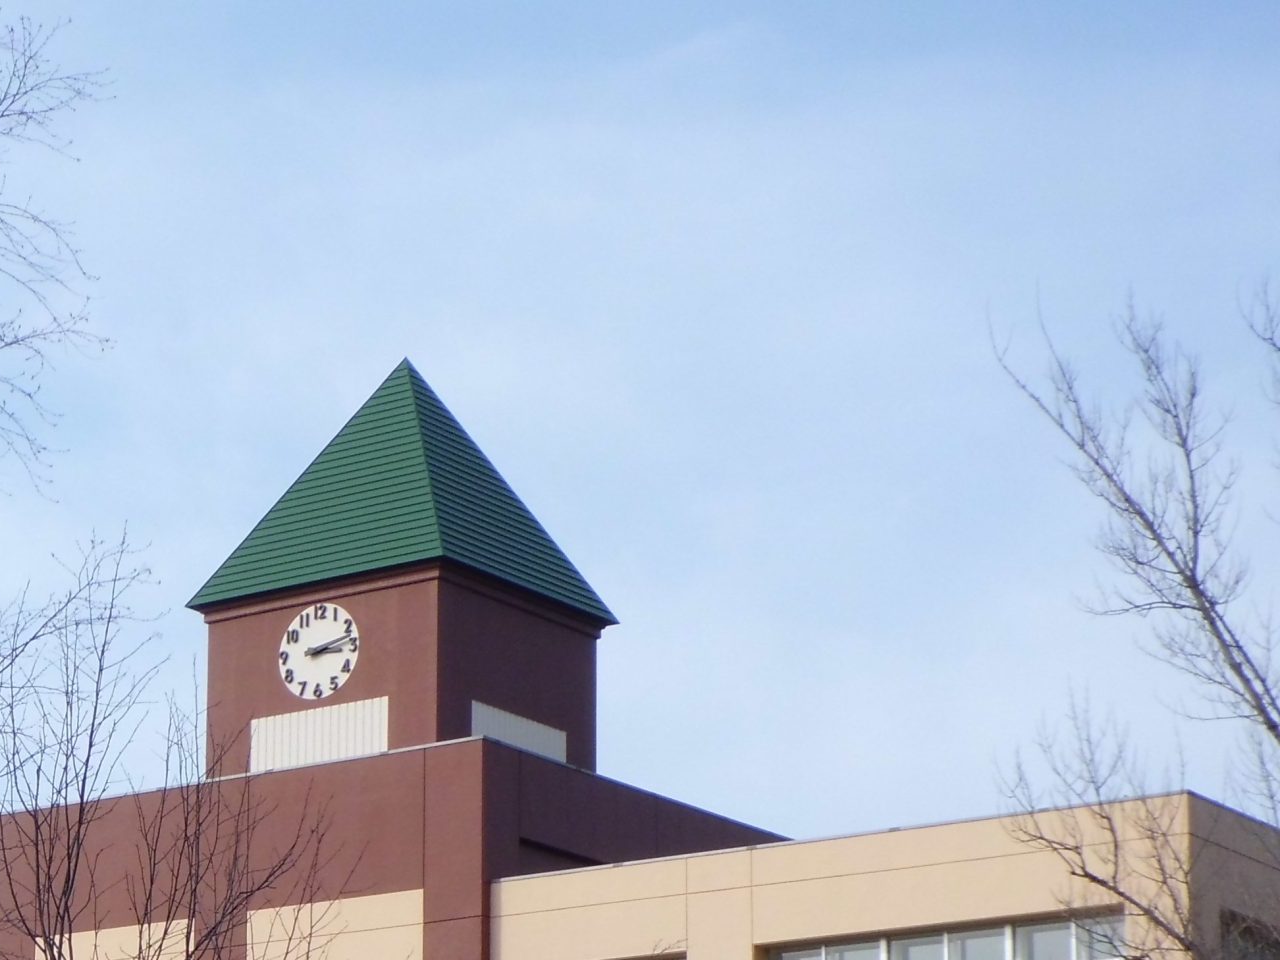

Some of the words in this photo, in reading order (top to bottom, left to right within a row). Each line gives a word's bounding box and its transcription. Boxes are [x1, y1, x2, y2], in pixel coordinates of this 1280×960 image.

[314, 604, 327, 620] 12
[333, 607, 338, 622] 1
[300, 613, 310, 629] 11
[344, 619, 353, 633] 2
[287, 629, 299, 644] 10
[349, 637, 357, 653] 3
[280, 651, 289, 665] 9
[341, 659, 351, 673] 4
[284, 669, 294, 684] 8
[329, 676, 338, 691] 5
[297, 681, 307, 696] 7
[313, 683, 322, 698] 6
